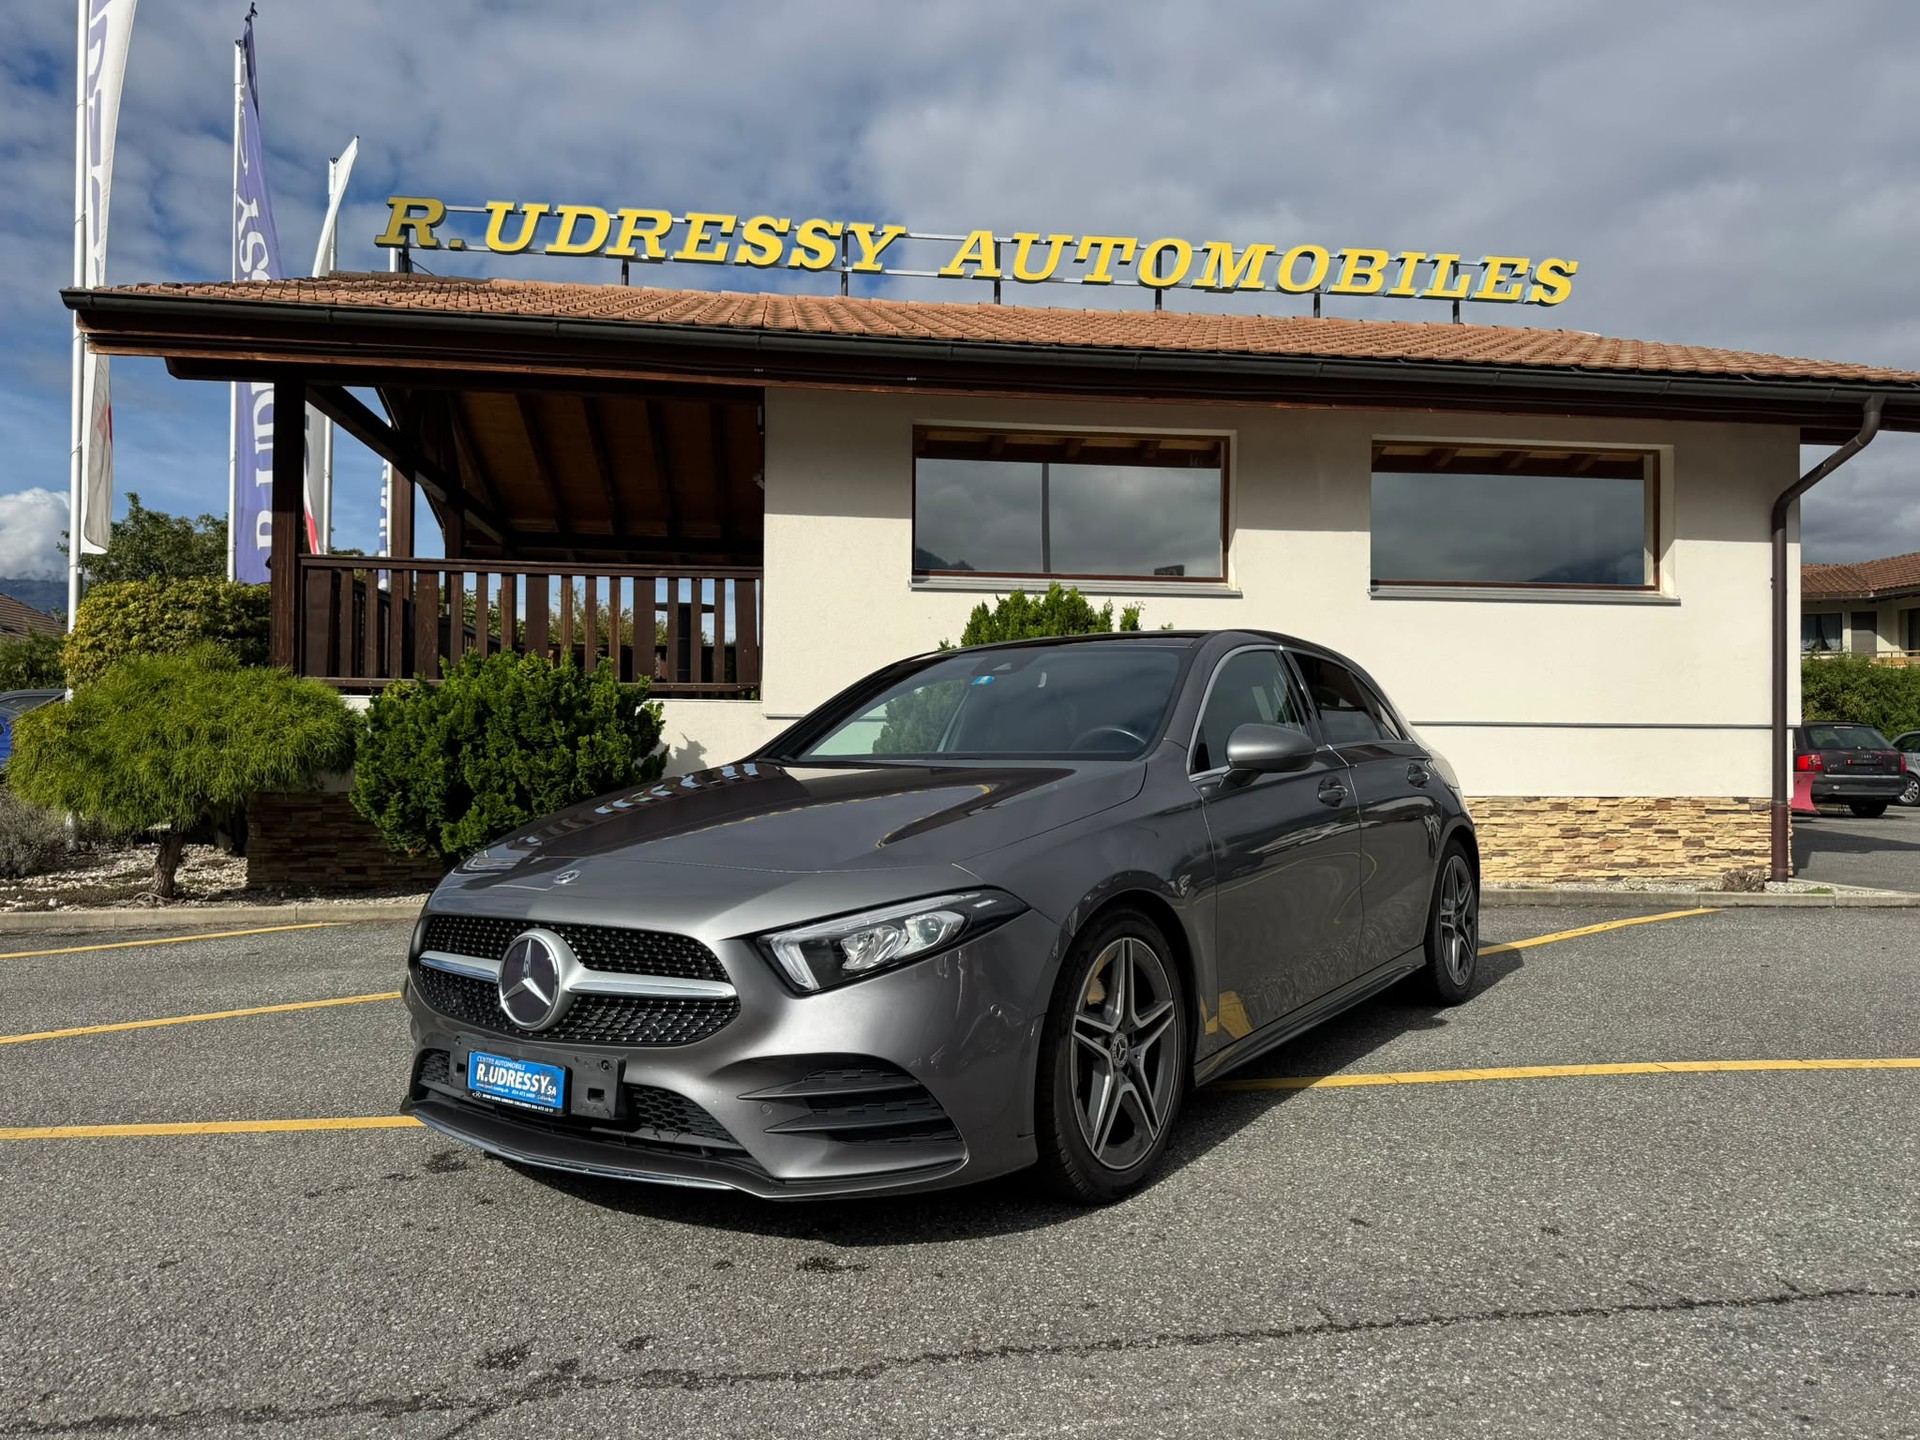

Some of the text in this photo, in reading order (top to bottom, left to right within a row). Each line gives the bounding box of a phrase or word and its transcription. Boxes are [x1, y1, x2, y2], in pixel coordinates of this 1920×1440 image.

[374, 196, 1579, 307] R. UDRESSY AUTOMOBILES
[476, 1063, 550, 1094] R.UDRESSY
[547, 1085, 557, 1096] SA
[494, 1059, 526, 1071] AUTOMOBILE
